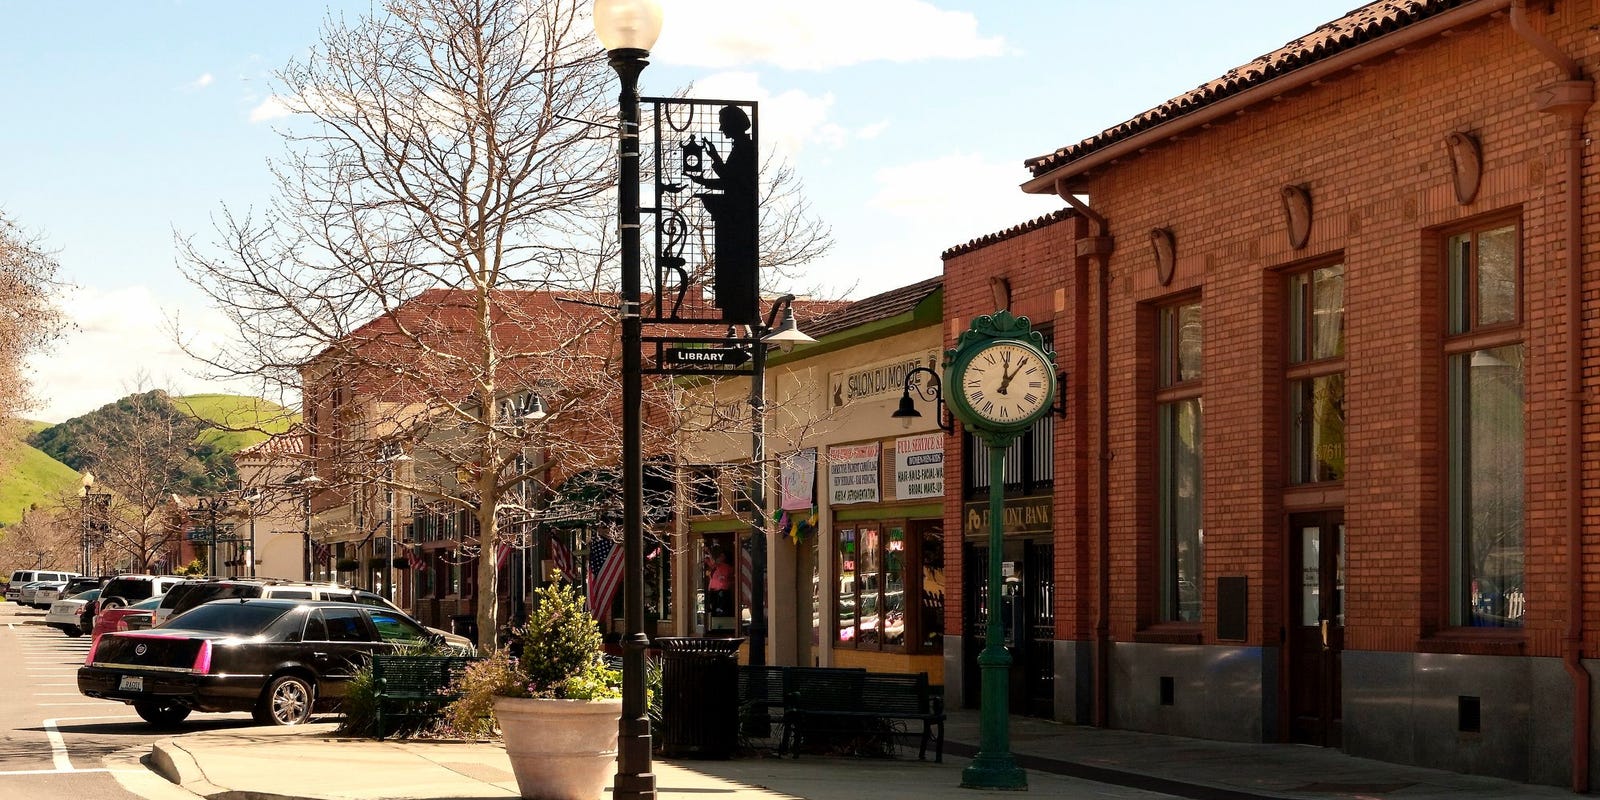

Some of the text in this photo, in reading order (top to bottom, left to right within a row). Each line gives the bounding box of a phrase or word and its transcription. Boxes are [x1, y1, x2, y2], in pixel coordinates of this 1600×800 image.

[678, 351, 724, 361] LIBRARY
[847, 359, 921, 398] SALON DU MONDE
[912, 436, 935, 452] SERVICE
[983, 507, 1023, 528] FONT
[1025, 505, 1049, 525] BANK
